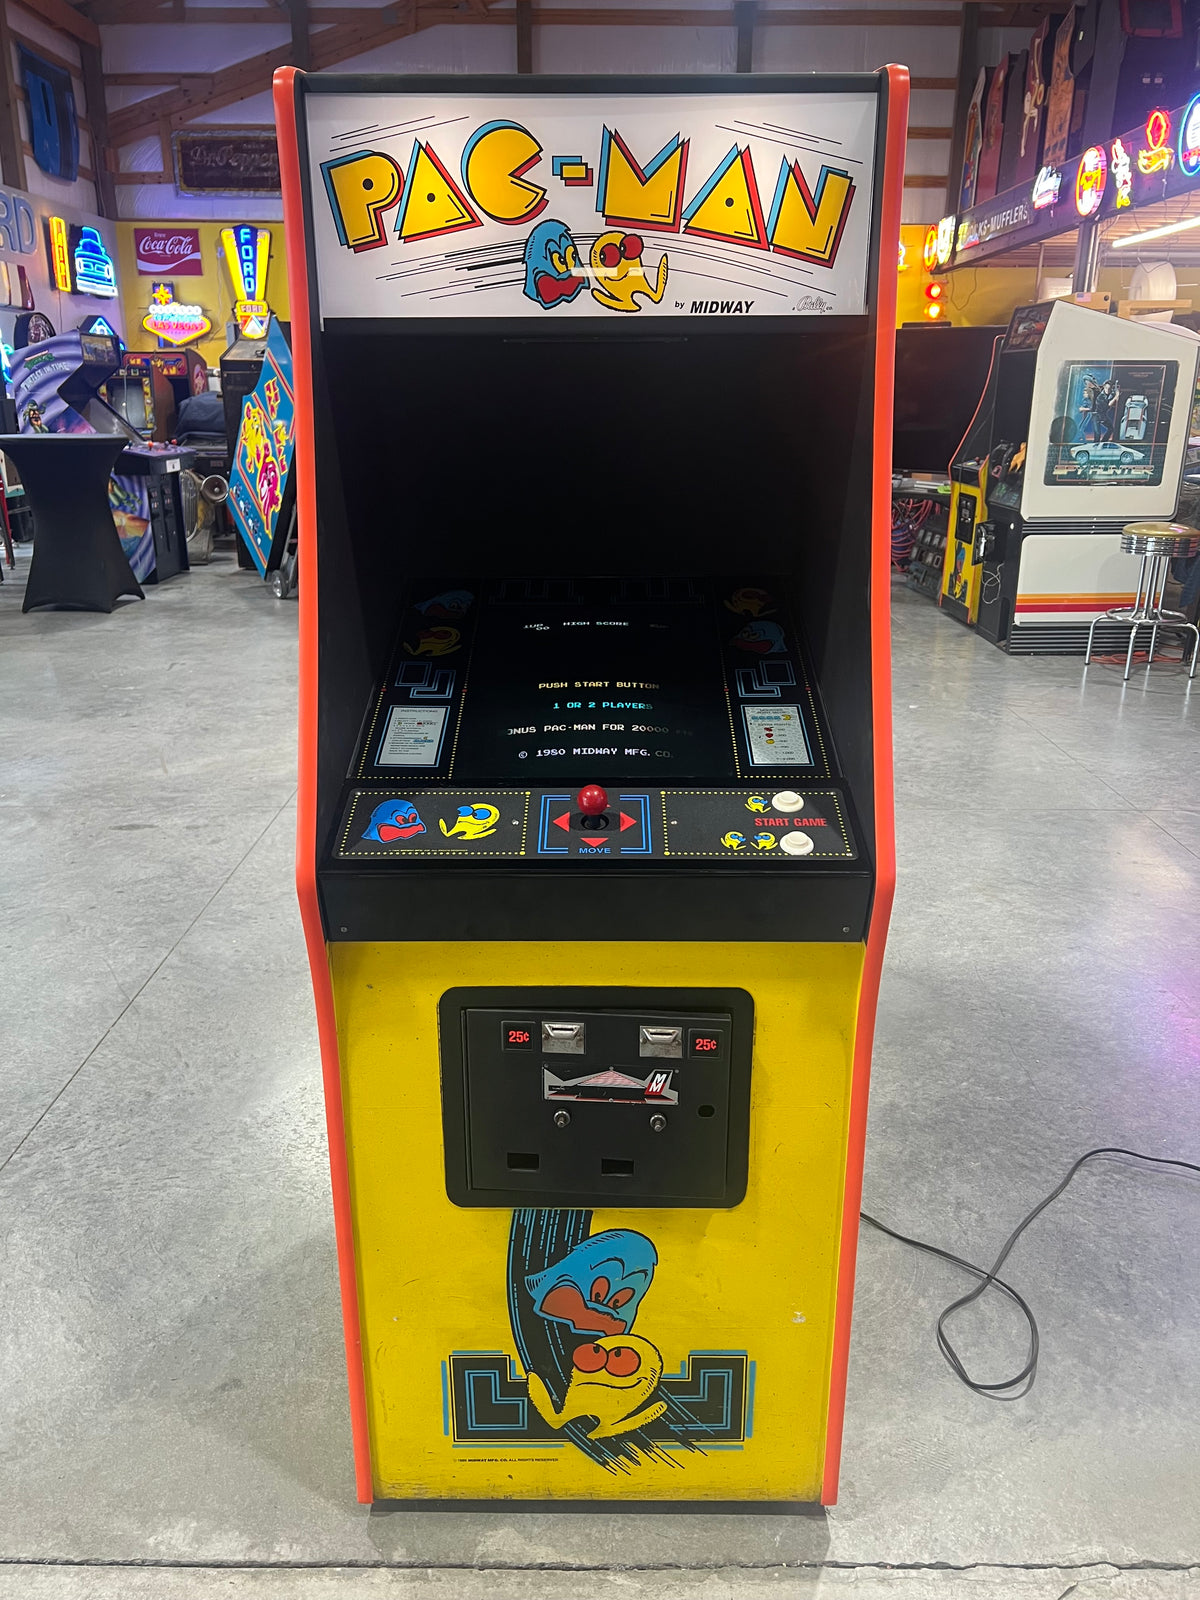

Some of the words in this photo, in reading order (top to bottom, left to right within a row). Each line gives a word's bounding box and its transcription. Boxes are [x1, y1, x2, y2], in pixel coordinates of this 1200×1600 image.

[319, 118, 856, 269] PAC-MAN
[139, 235, 194, 255] Coca-Cola
[240, 228, 255, 293] FORD
[240, 304, 264, 314] FORD
[674, 300, 685, 309] by
[690, 300, 755, 314] MIDWAY
[1052, 464, 1088, 475] SPY
[1088, 464, 1155, 476] HUNTER
[538, 682, 568, 690] PUSH
[616, 681, 660, 690] BUTTON
[553, 702, 560, 710] 1
[588, 701, 596, 709] 2
[602, 701, 653, 710] PLAYERS
[543, 723, 596, 732] PAC-MAN
[602, 723, 625, 732] FOR
[631, 724, 670, 734] 20000
[536, 748, 566, 758] 1980
[573, 747, 618, 756] MIDWAY
[624, 748, 651, 757] MFG.
[754, 817, 790, 827] START
[793, 817, 828, 827] GAME
[508, 1030, 530, 1043] 25¢
[695, 1038, 717, 1051] 25¢
